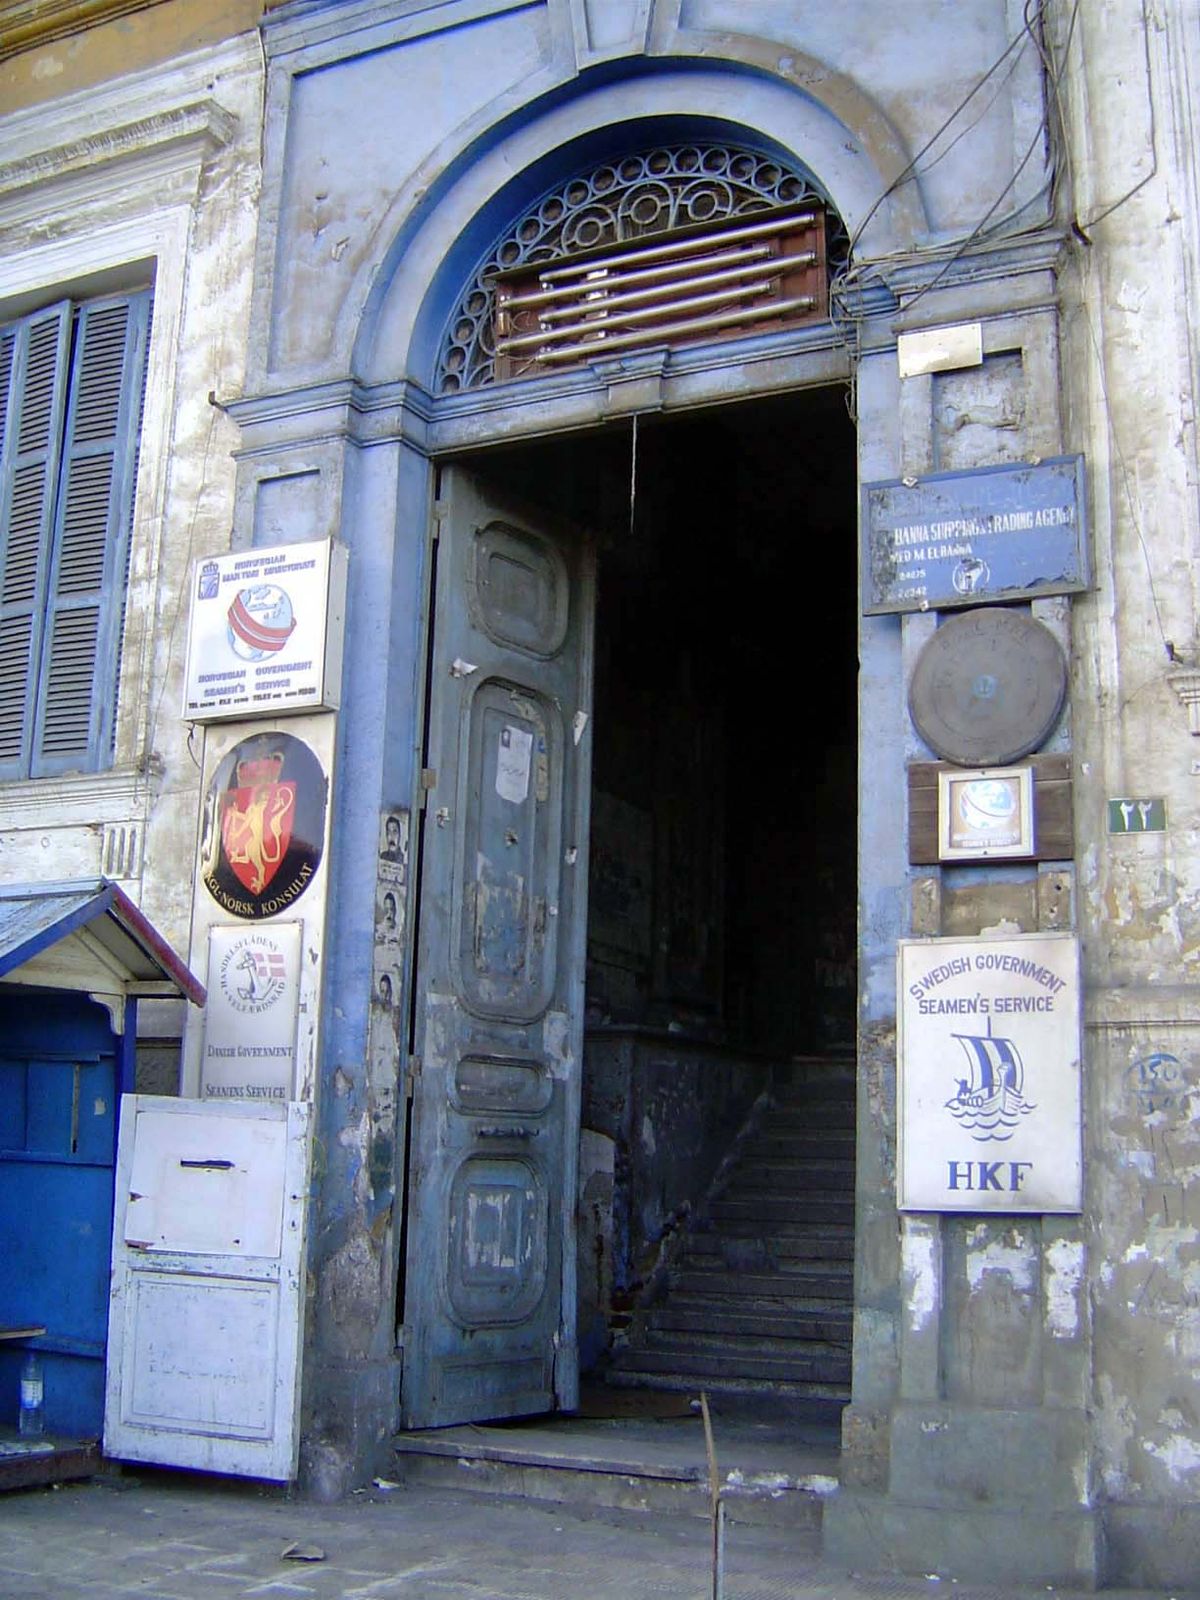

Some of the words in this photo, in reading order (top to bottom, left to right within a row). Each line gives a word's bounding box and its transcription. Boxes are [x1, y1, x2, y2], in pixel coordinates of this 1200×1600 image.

[927, 546, 940, 560] EL
[221, 892, 255, 915] NORSK
[261, 862, 313, 915] KONSULAT
[909, 957, 972, 1001] SWEDISH
[975, 954, 1067, 994] GOVERNMENT
[918, 993, 990, 1015] SEAMEN'S
[994, 996, 1054, 1013] SERVICE
[246, 1084, 286, 1098] SERVICE
[947, 1160, 1033, 1192] HKF
